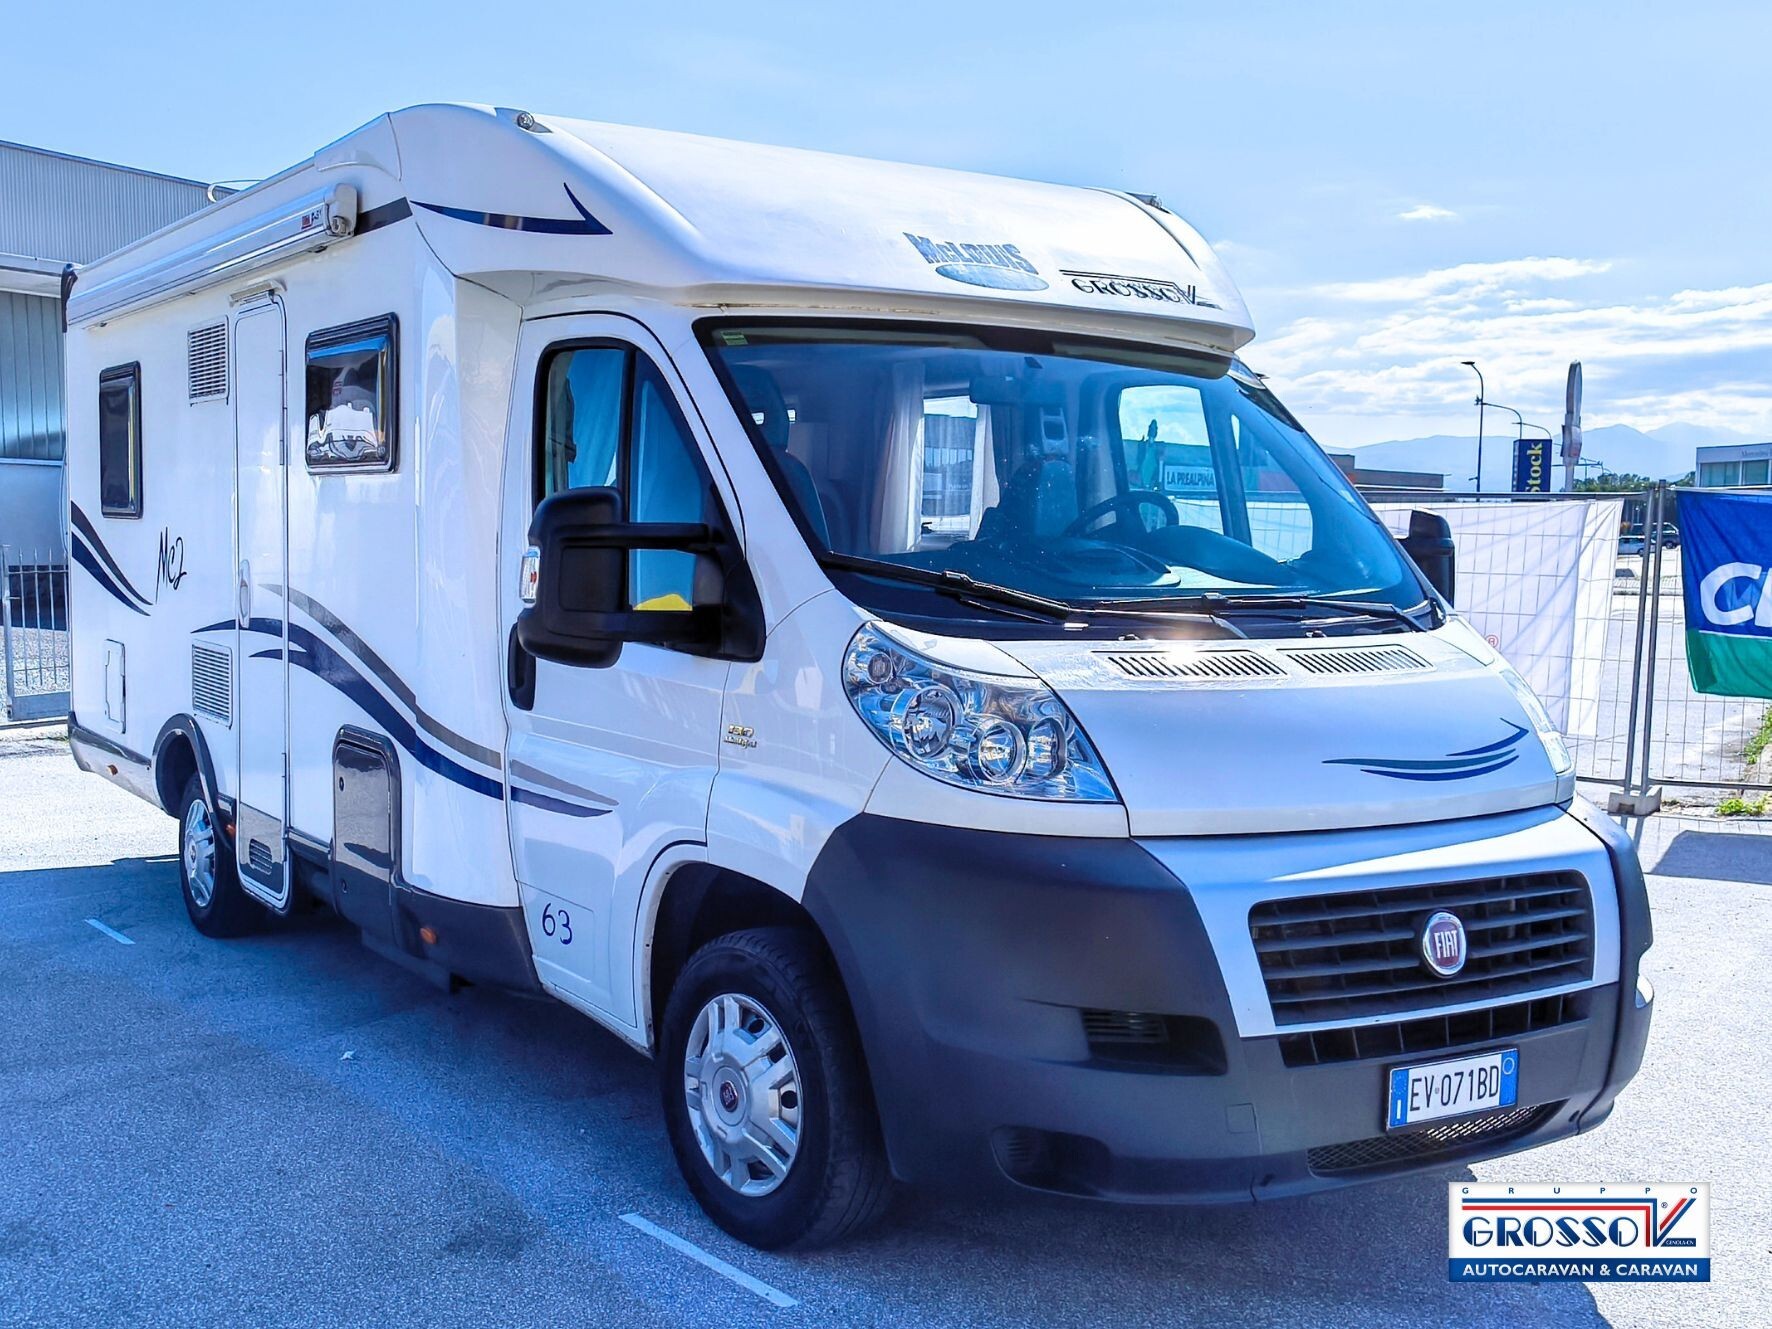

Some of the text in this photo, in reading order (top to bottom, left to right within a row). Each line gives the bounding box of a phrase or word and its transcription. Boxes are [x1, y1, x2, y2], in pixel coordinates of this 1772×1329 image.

[1167, 471, 1215, 486] LA PREALPINA
[542, 902, 572, 945] 63
[1433, 930, 1458, 959] FIAT
